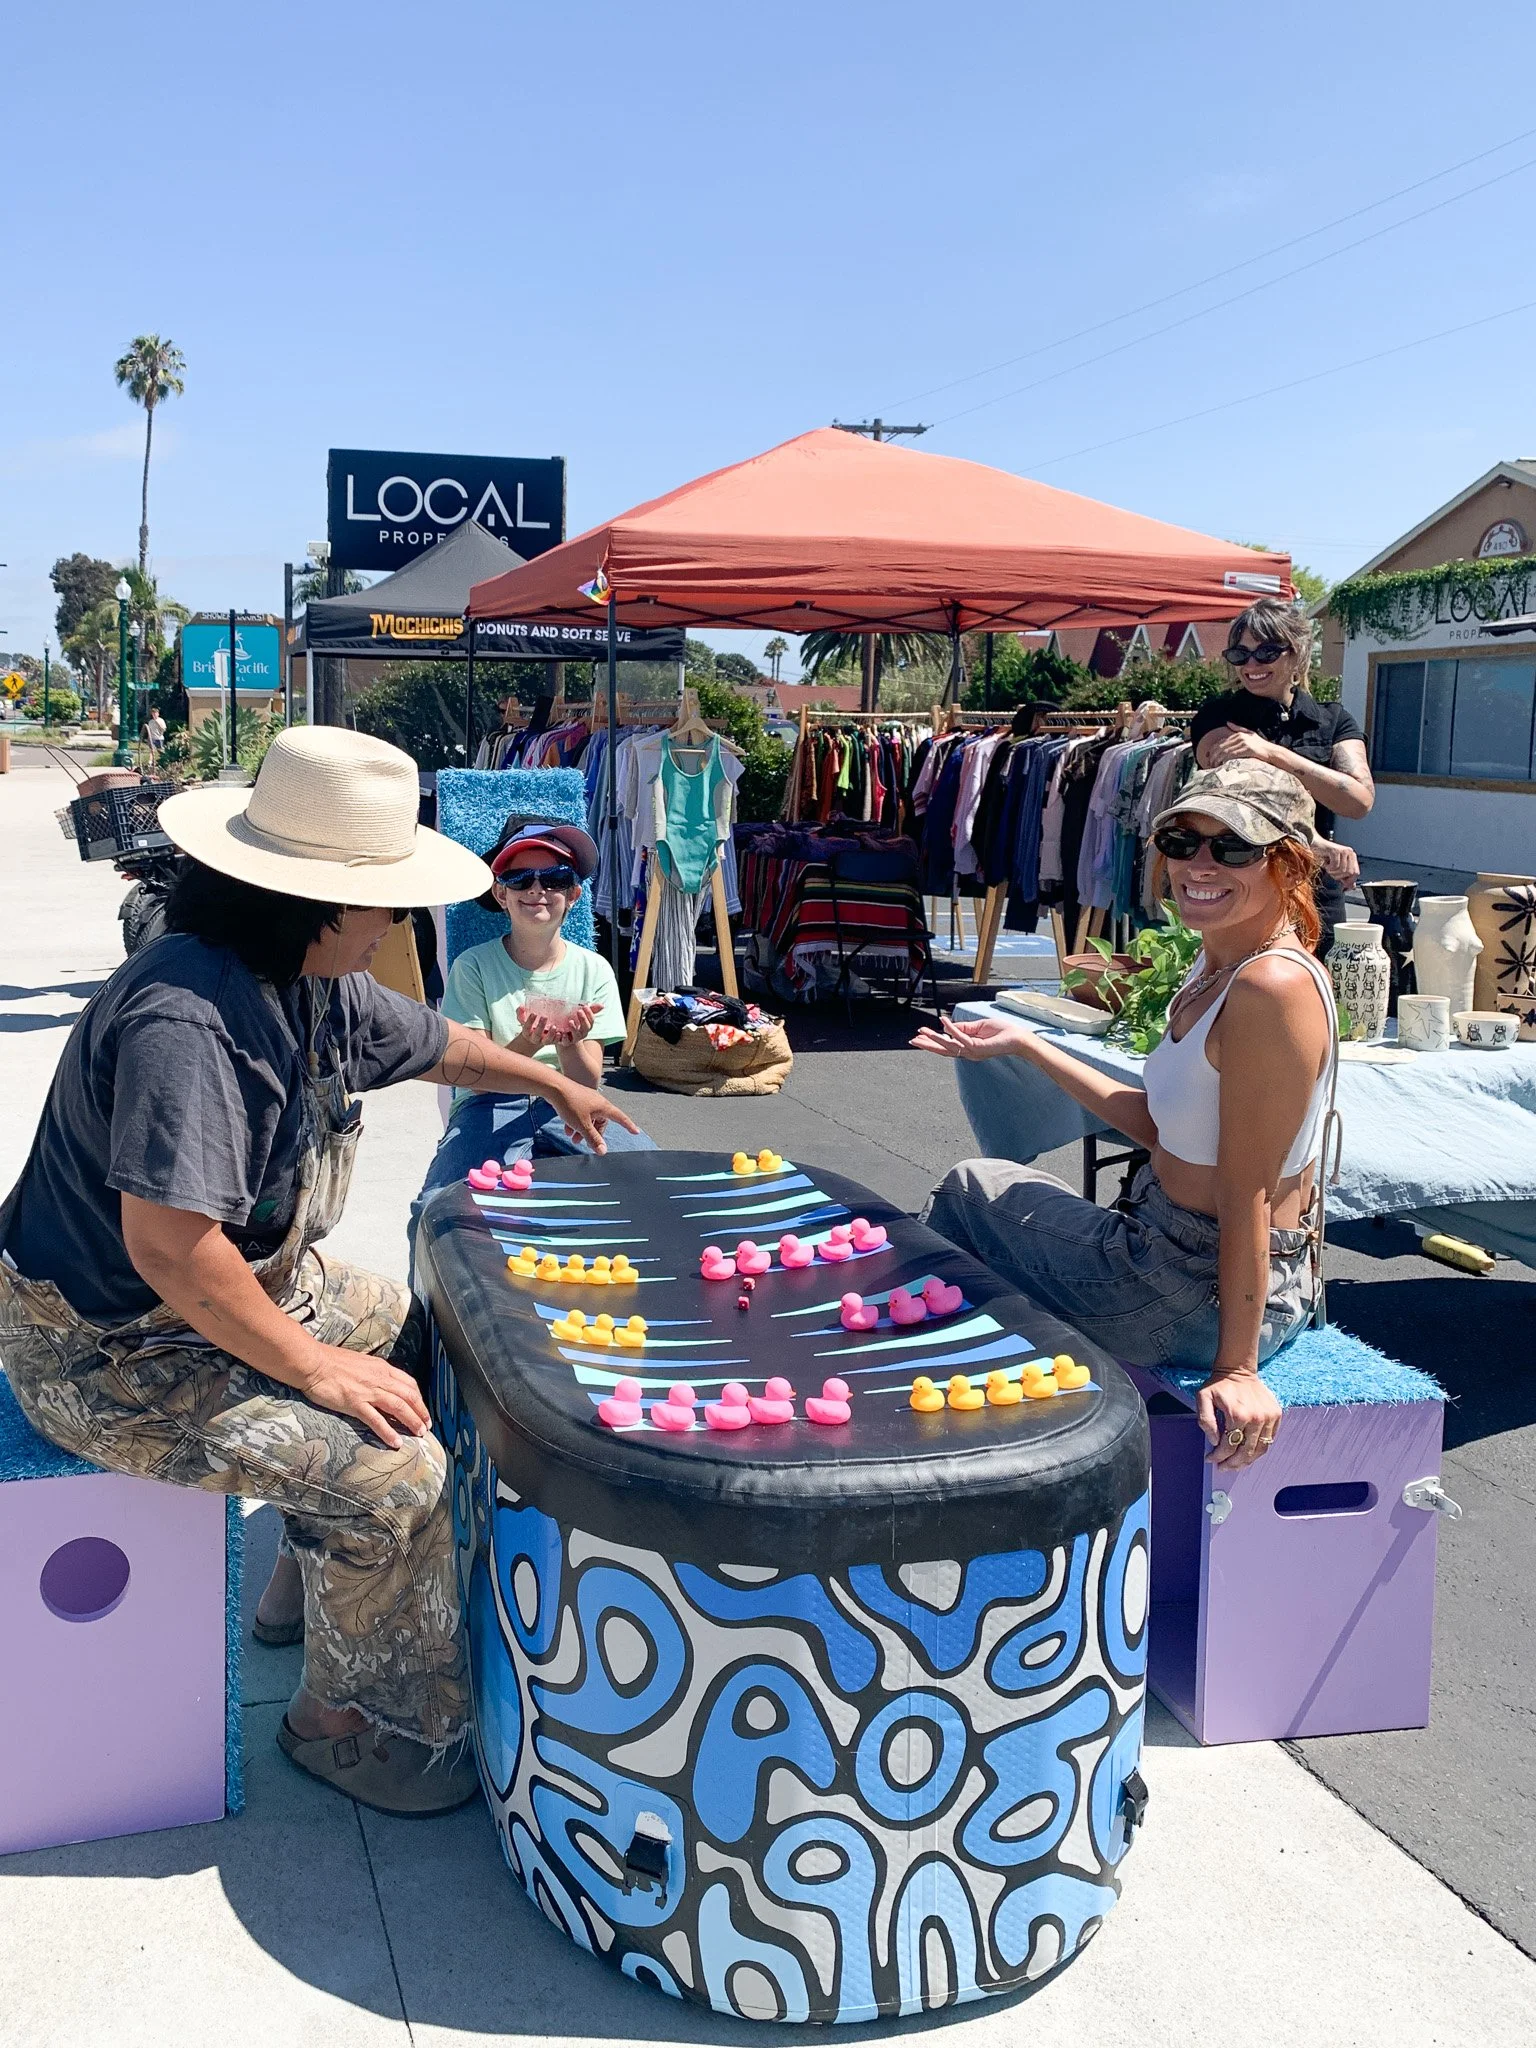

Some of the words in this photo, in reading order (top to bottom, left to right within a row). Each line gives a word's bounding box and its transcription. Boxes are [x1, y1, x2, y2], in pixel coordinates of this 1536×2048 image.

[347, 474, 550, 529] LOCAL
[369, 613, 464, 639] MOCHICHIS
[476, 622, 528, 636] DONUTS
[530, 625, 559, 638] AND
[561, 627, 592, 640] SOFT
[595, 630, 631, 643] SEVE
